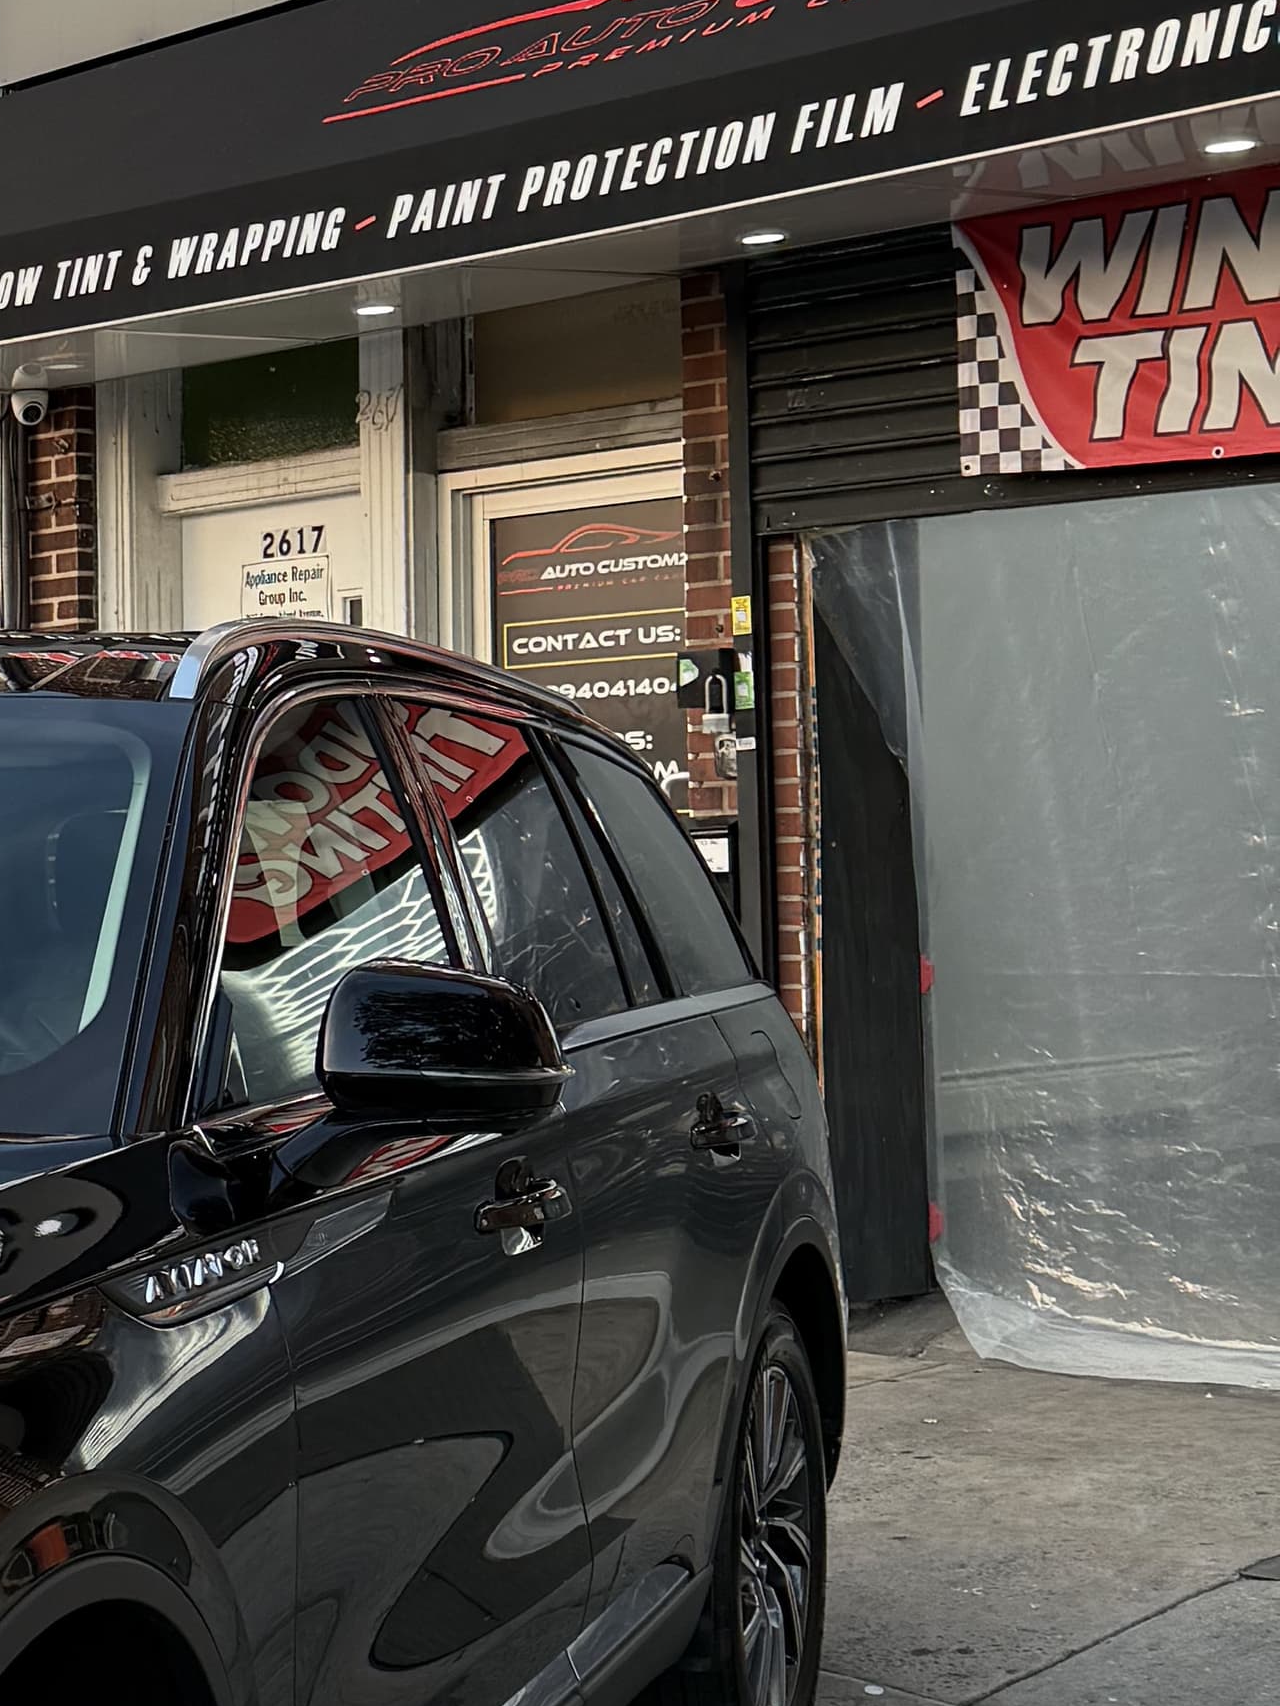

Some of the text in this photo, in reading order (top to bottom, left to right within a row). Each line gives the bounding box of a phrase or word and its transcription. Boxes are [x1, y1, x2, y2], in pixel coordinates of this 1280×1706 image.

[533, 6, 776, 77] PREMIUM
[344, 46, 501, 102] PRO
[53, 250, 125, 301] TINT
[132, 245, 153, 285] &
[166, 206, 347, 280] WRAPPING
[386, 174, 507, 240] PAINT
[516, 111, 777, 213] PROTECTION
[790, 81, 905, 157] FILM
[262, 525, 326, 559] 2617
[245, 563, 325, 588] Appliance Repair
[540, 562, 596, 580] AUTO
[258, 588, 308, 607] Group Inc.
[512, 624, 682, 655] CONTACT US:
[545, 676, 678, 700] 9404140
